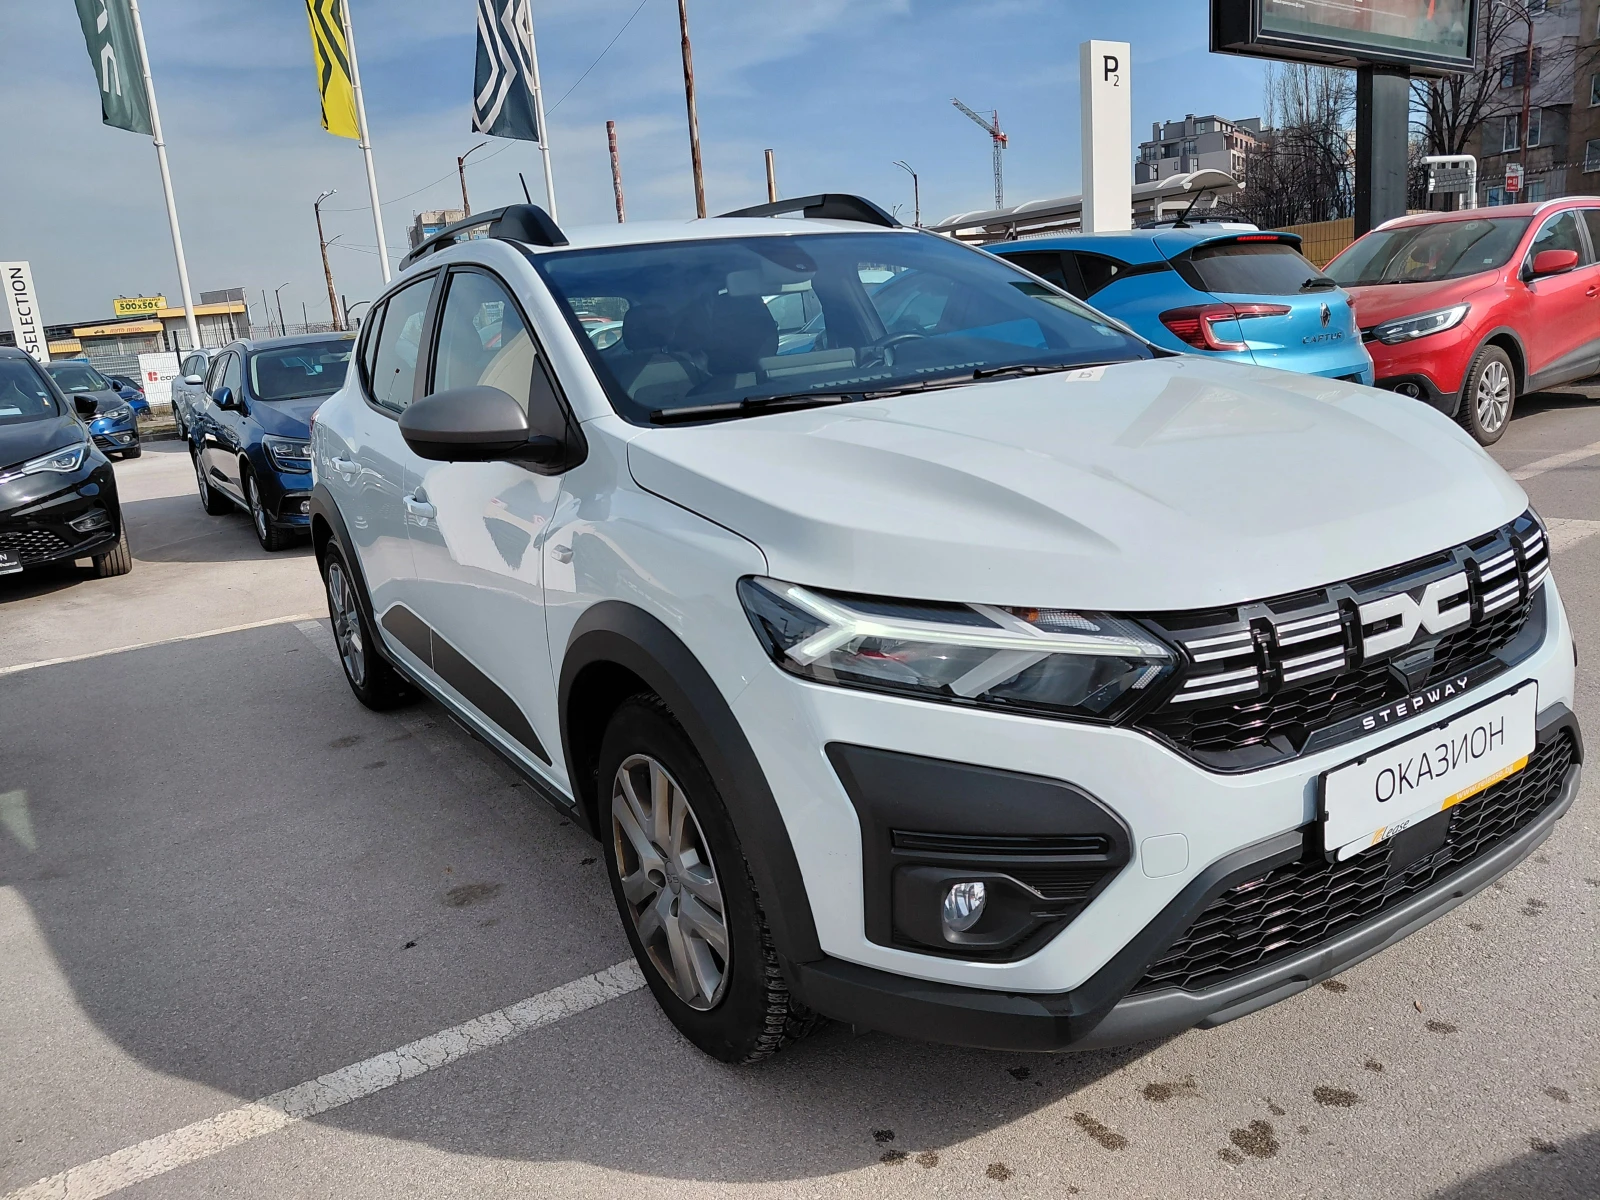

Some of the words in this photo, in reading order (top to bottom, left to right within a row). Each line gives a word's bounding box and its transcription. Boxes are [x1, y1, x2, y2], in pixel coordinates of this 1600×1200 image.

[9, 268, 40, 354] SELECTION
[1302, 331, 1342, 344] CAPTUR
[1362, 676, 1468, 730] STEPWAY
[1375, 715, 1504, 803] ОКАЗИОН
